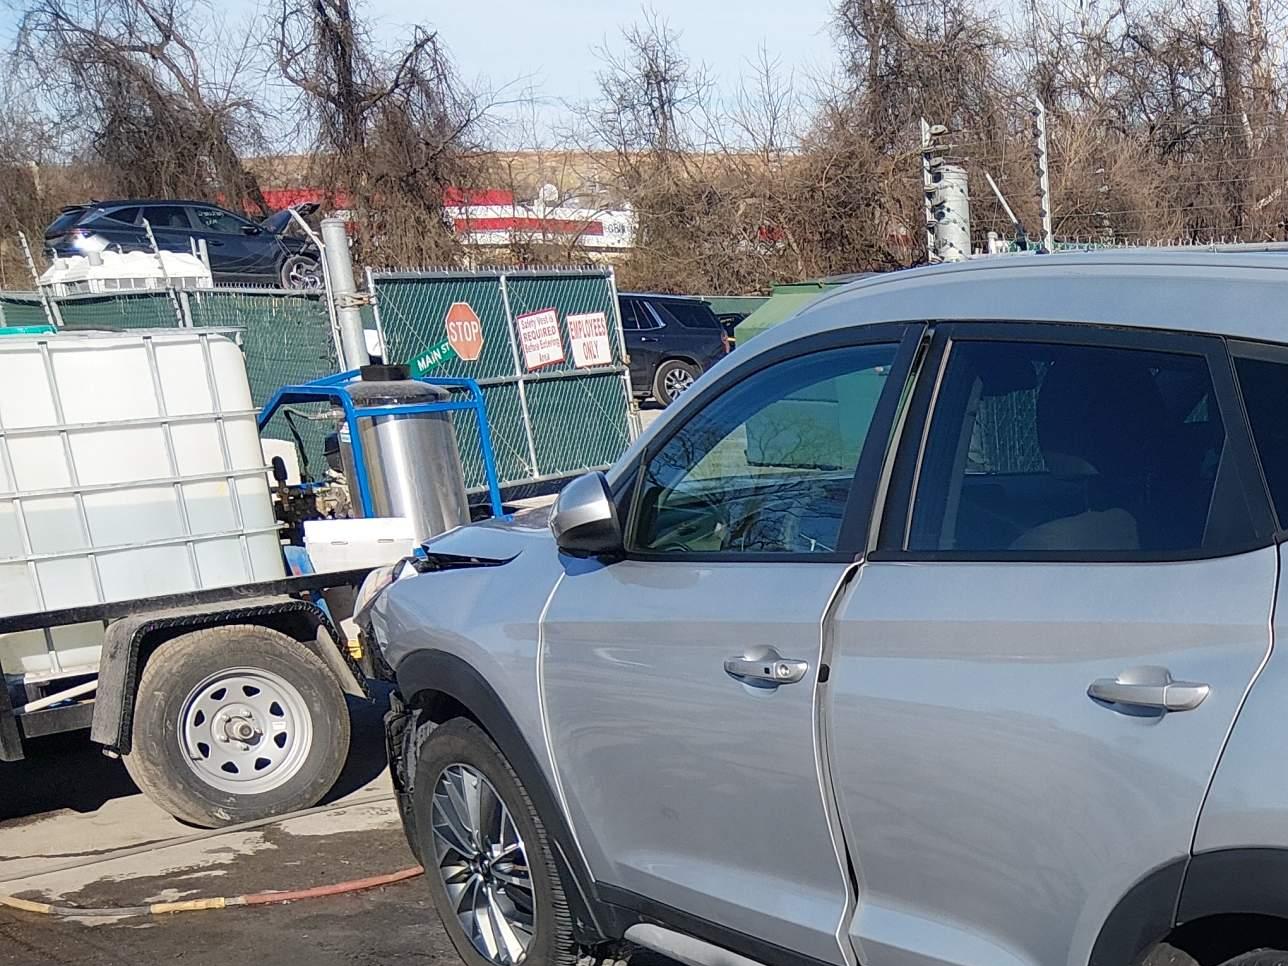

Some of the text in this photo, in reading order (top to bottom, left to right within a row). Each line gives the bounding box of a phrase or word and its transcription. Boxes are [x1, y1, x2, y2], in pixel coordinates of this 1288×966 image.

[449, 321, 479, 342] STOP
[521, 317, 536, 330] Safety
[537, 314, 549, 325] Vest
[569, 317, 606, 340] EMPLOYEES
[523, 326, 556, 341] REQUIRED
[540, 338, 561, 350] Entering
[417, 342, 450, 372] MAIN ST
[583, 340, 600, 361] ONLY
